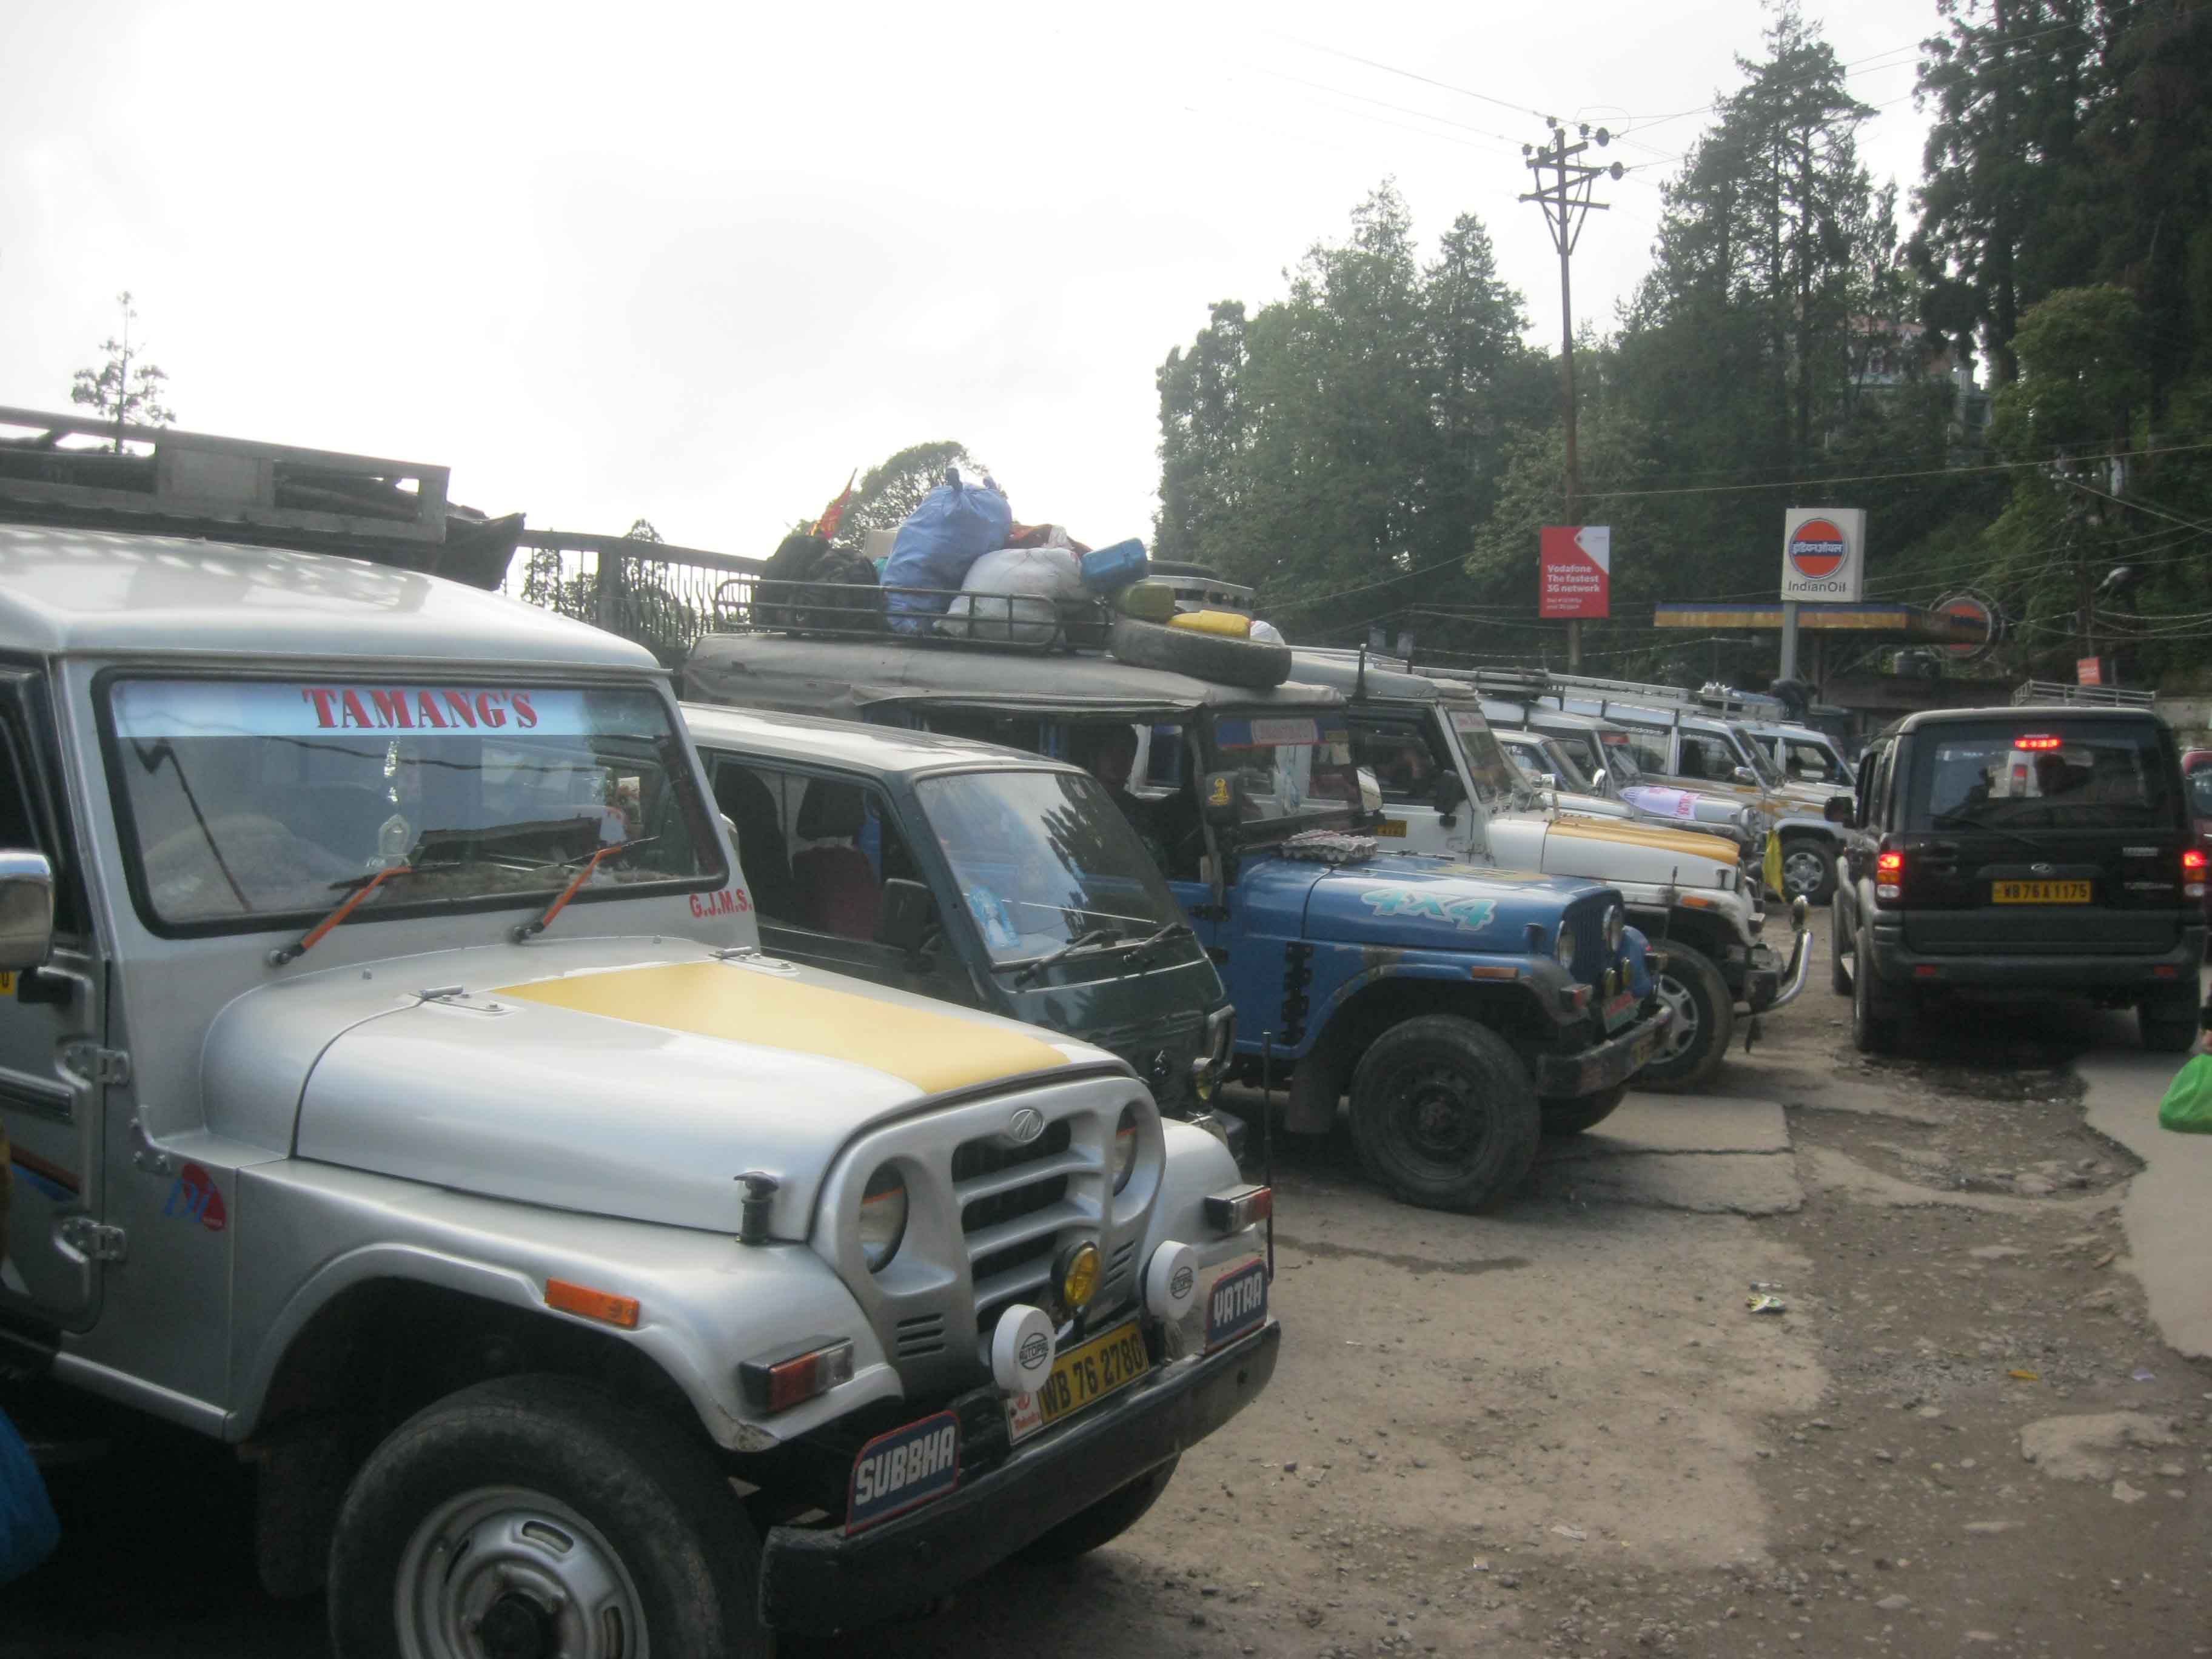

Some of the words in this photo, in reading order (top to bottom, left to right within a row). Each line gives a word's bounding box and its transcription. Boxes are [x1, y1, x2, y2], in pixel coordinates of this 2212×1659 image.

[1547, 564, 1592, 573] Vodafone
[1547, 574, 1564, 583] The
[1566, 574, 1599, 583] fastest
[1547, 584, 1560, 592] 3G
[1561, 584, 1601, 592] network
[1788, 580, 1846, 592] IndianOil
[301, 688, 538, 728] TAMANG'S
[1214, 1272, 1262, 1327] YATRA
[1041, 1369, 1071, 1416] WB
[1072, 1356, 1098, 1399] 76
[854, 1426, 956, 1506] SUBBHA
